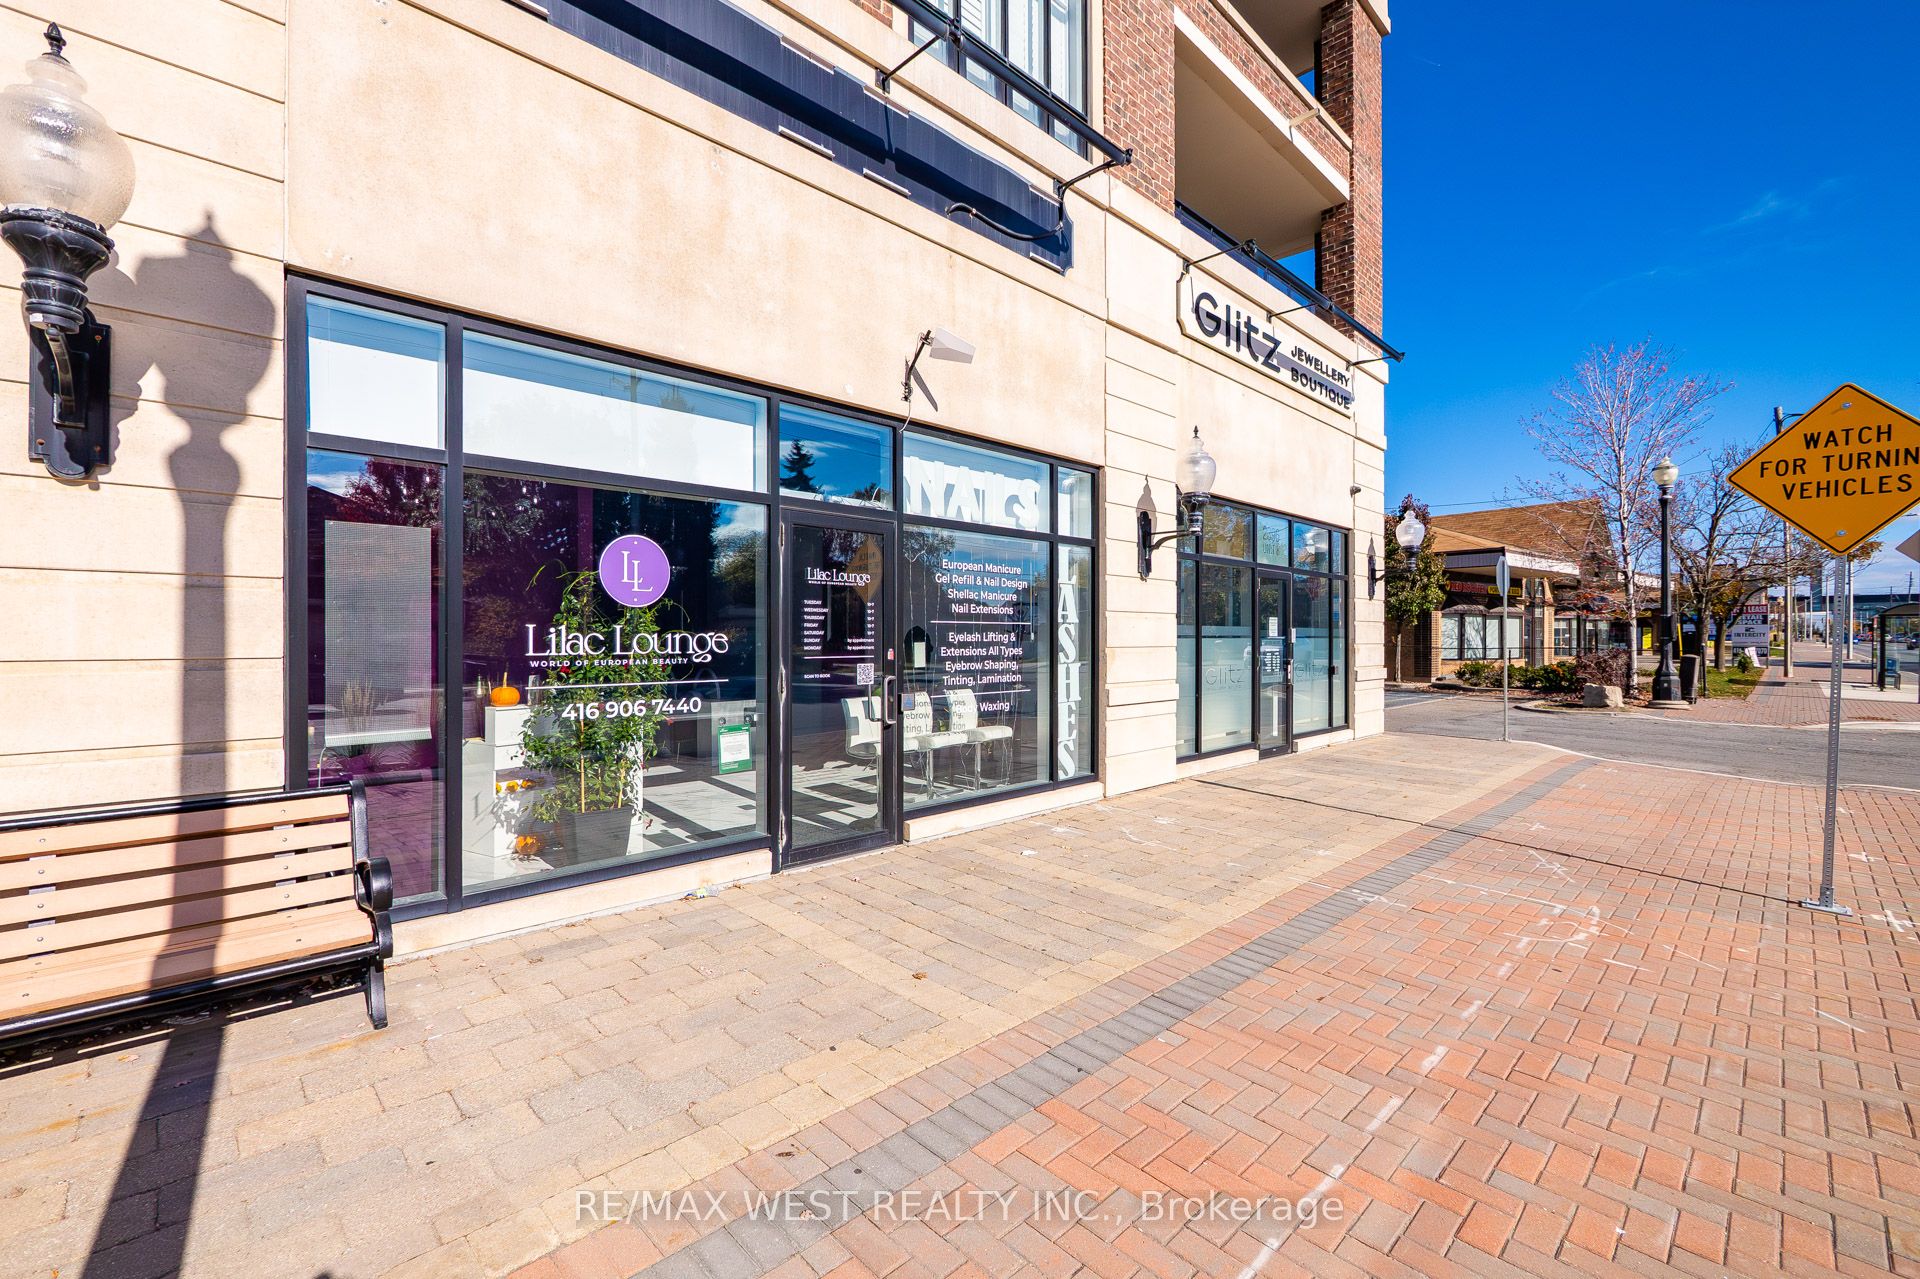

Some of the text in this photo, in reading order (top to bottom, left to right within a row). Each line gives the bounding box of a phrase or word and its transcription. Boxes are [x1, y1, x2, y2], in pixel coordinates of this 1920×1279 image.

[1195, 292, 1282, 373] Glitz
[1291, 346, 1350, 387] JEWELLERY
[1291, 367, 1350, 410] BOUTIQUE
[1803, 423, 1892, 449] WATCH
[1760, 458, 1807, 478] FOR
[903, 456, 1040, 531] NAILS
[1782, 473, 1913, 501] VEHICLES
[807, 567, 871, 586] Lilac Lounge
[942, 559, 1022, 575] European Manicure
[935, 573, 1028, 590] Gel Refill & Nail Design
[947, 588, 1017, 602] Shellac Manicure
[952, 603, 1014, 615] Nail Extensions
[525, 624, 729, 662] Lilac Lounge
[948, 632, 1016, 644] Eyelash Lifting &
[940, 646, 1022, 658] Extensions All Types
[530, 660, 571, 668] WORLD
[594, 658, 648, 666] EUROPEAN
[652, 657, 689, 665] BEAUTY
[946, 660, 1019, 673] Eyebrow Shaping,
[1058, 546, 1081, 781] LASHES
[943, 674, 1022, 687] Tinting, Lamination
[1206, 664, 1245, 685] Glitz
[561, 696, 702, 720] 416 906 7440
[980, 700, 1010, 712] Waxing
